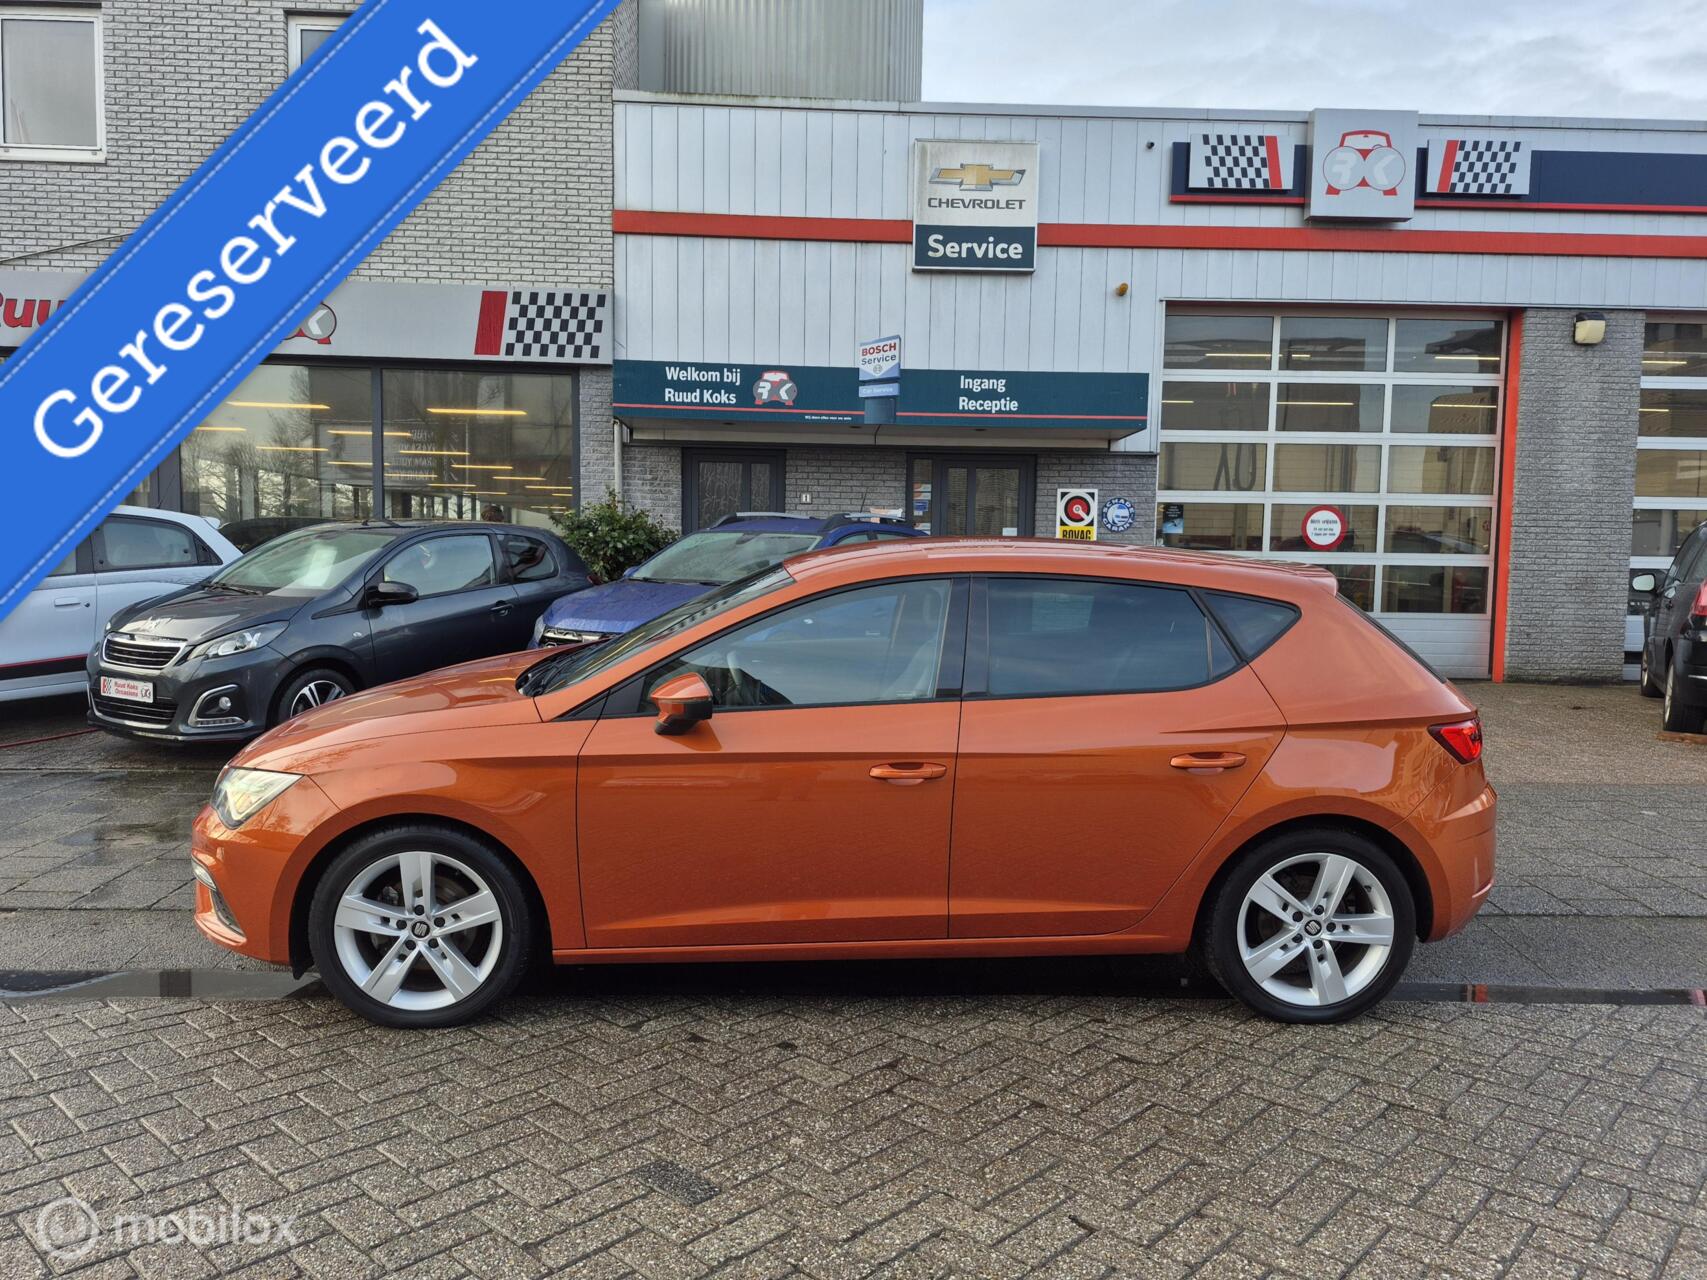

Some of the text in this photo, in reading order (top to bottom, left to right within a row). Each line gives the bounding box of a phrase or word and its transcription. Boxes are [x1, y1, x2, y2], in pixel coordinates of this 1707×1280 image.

[927, 197, 1026, 210] CHEVROLET
[927, 233, 1023, 259] Service
[861, 342, 897, 357] BOSCH
[861, 354, 897, 366] Service
[665, 366, 741, 386] Welkom bij
[960, 375, 1007, 393] Ingang
[664, 388, 737, 404] Ruud Koks
[959, 396, 1019, 414] Receptie
[1103, 499, 1134, 513] SCHADE
[1103, 518, 1133, 531] GARANT
